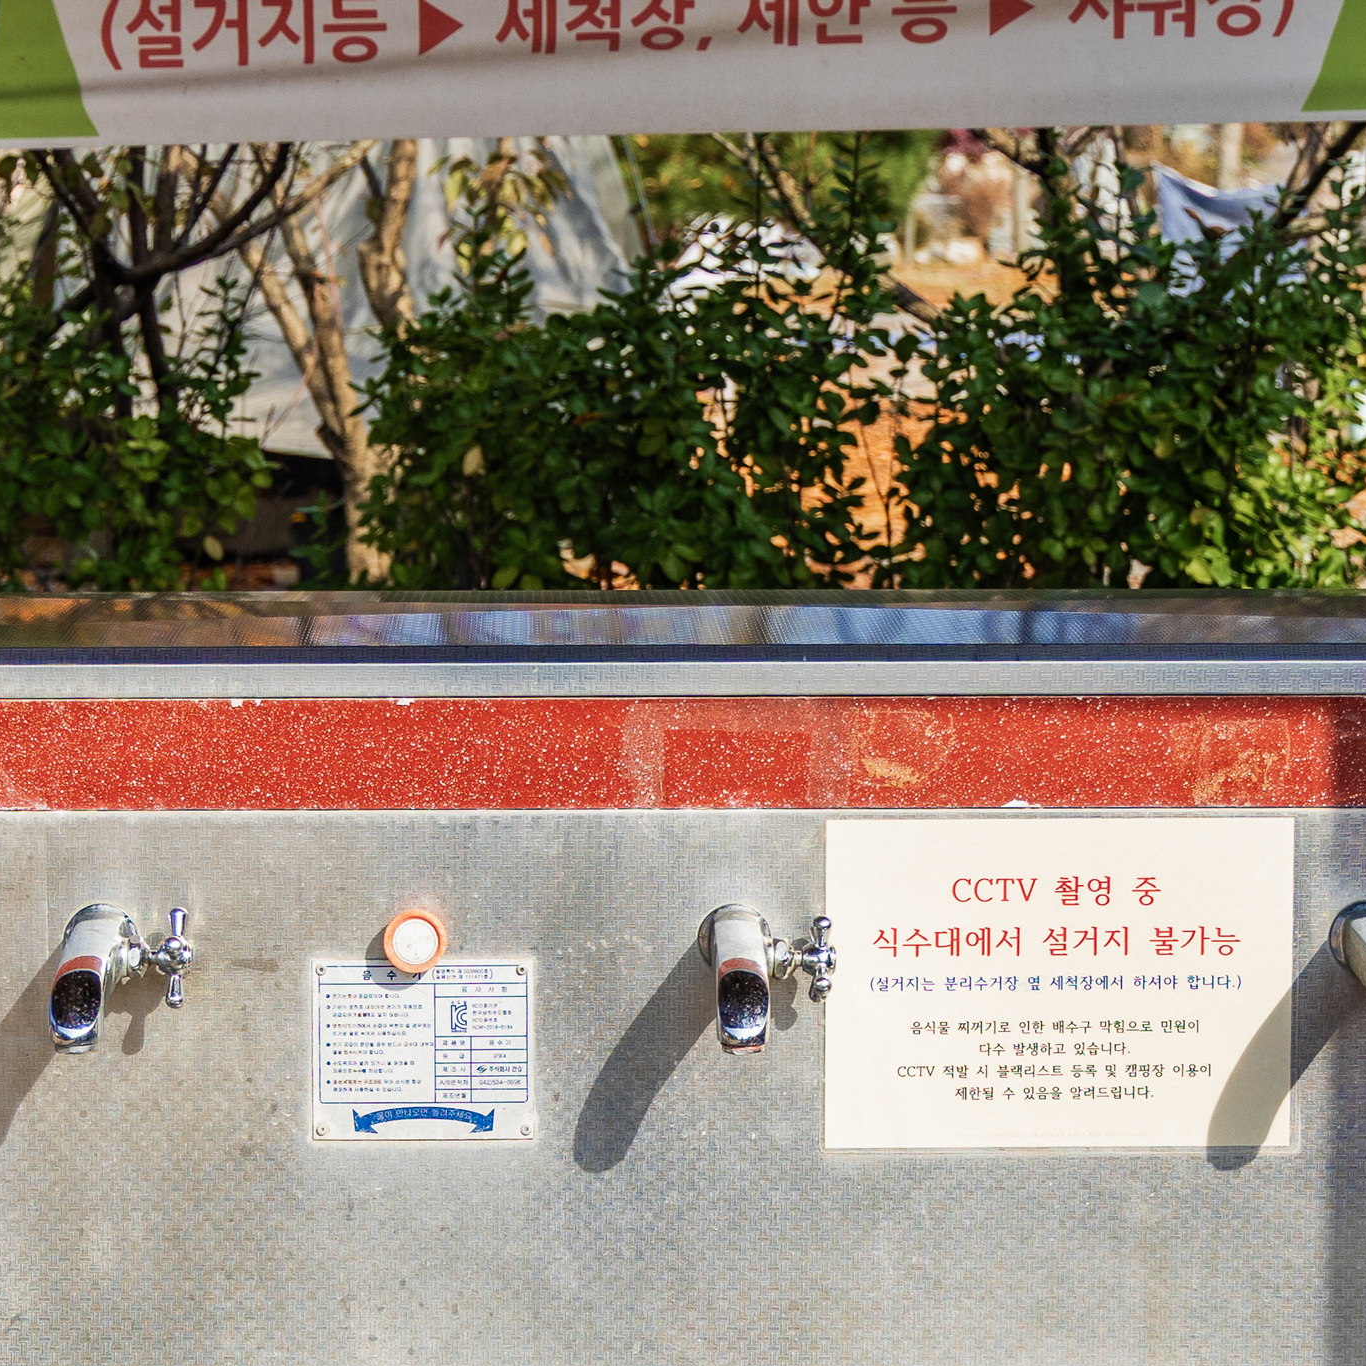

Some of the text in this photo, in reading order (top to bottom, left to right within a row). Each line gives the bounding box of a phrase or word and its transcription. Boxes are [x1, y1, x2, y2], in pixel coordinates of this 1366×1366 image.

[952, 876, 1161, 906] CCTV 촬영 중
[873, 926, 1240, 957] 식수대에서 설거지 불가능
[871, 975, 1241, 991] (설거지는 분리수거장 옆 세척장에서 하셔야 합니다.)
[910, 1020, 1198, 1035] 음식물 찌꺼기로 인한 배수구 막힘으로 민원이
[979, 1042, 1130, 1056] 다수 발생하고 있습니다.
[897, 1064, 1211, 1078] CCTV 적발 시 블랙리스트 등록 및 캠핑장 이용이
[955, 1086, 1153, 1100] 제한될 수 있음을 알려드립니다.
